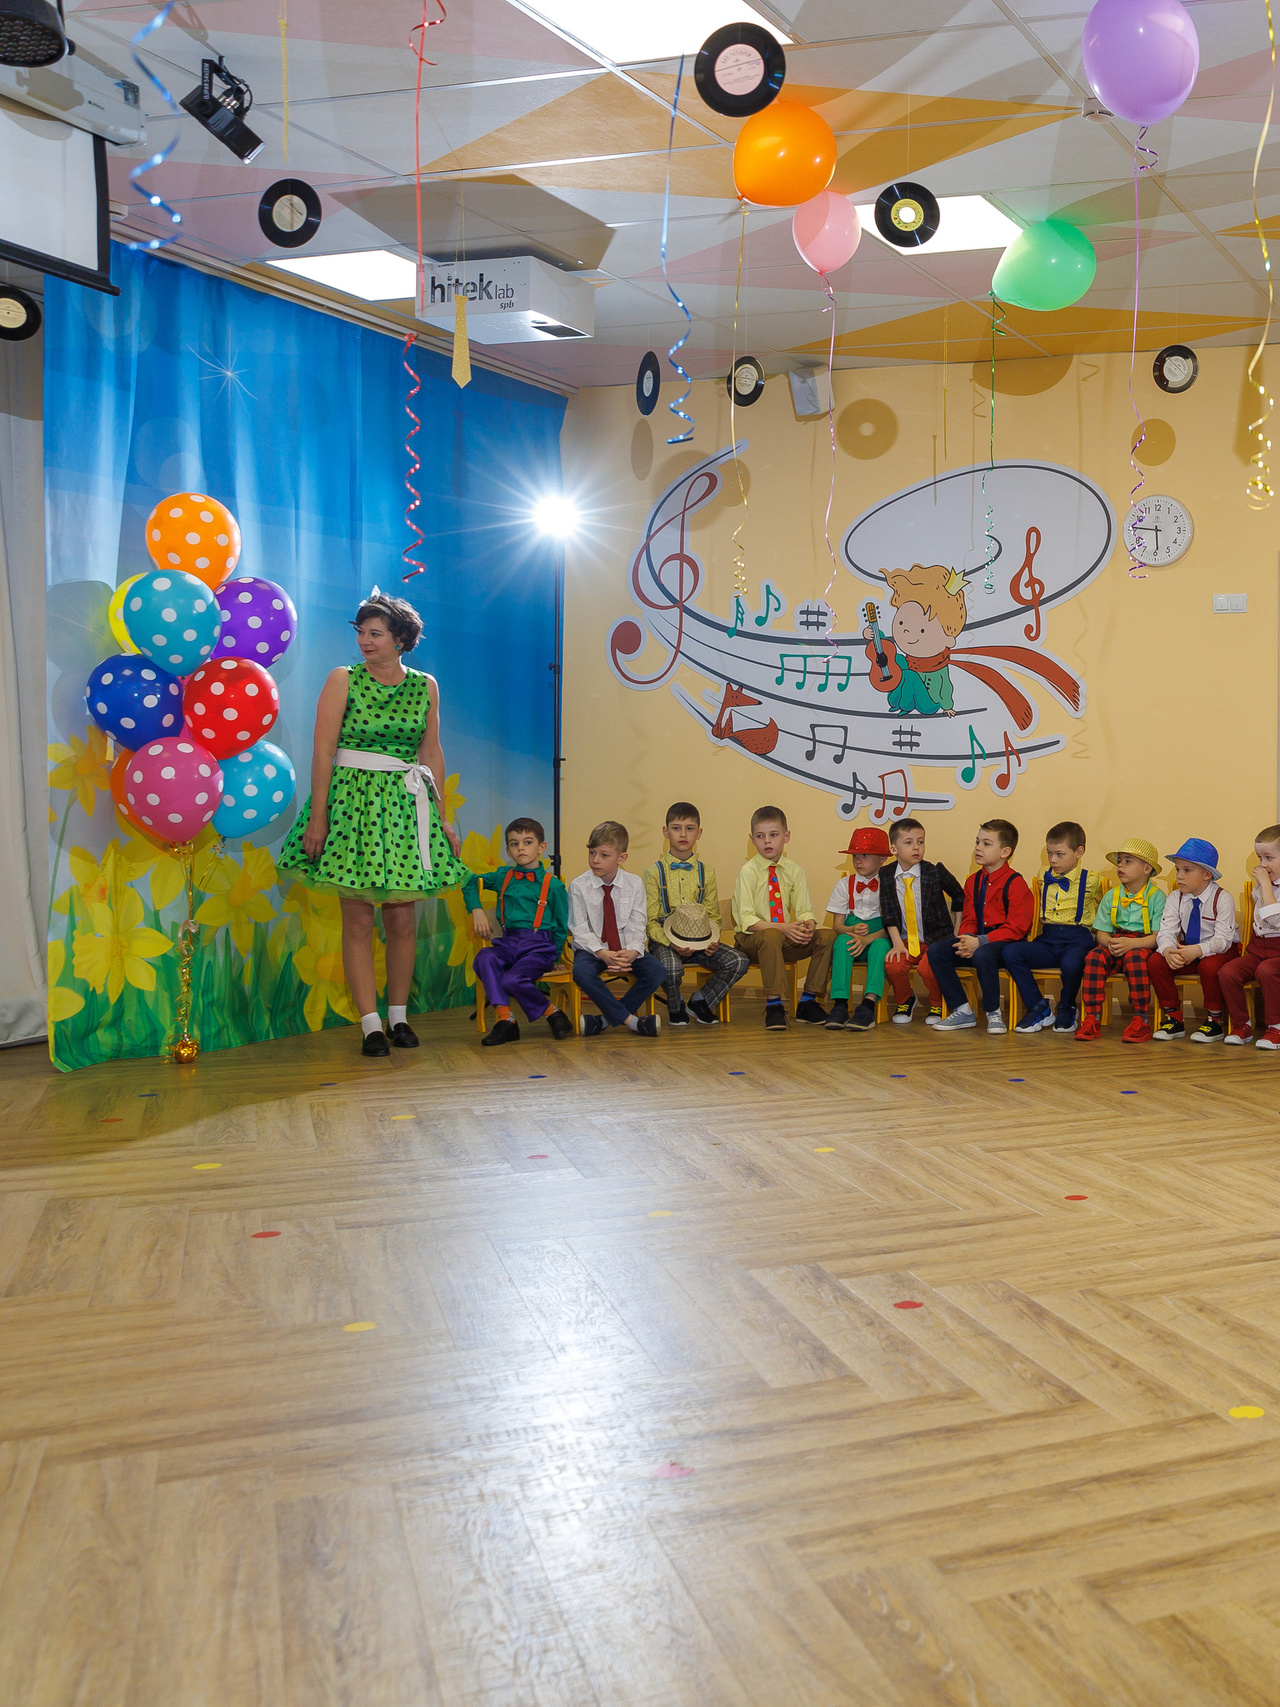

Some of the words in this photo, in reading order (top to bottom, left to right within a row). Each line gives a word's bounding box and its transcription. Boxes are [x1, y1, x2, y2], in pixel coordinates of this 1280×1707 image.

[431, 273, 493, 303] hitek
[1154, 503, 1162, 512] 12
[1173, 515, 1179, 523] 2
[1176, 526, 1182, 535] 3
[1172, 537, 1178, 545] 4
[1143, 545, 1148, 554] 7
[1152, 549, 1158, 557] 6
[1165, 545, 1171, 554] 5
